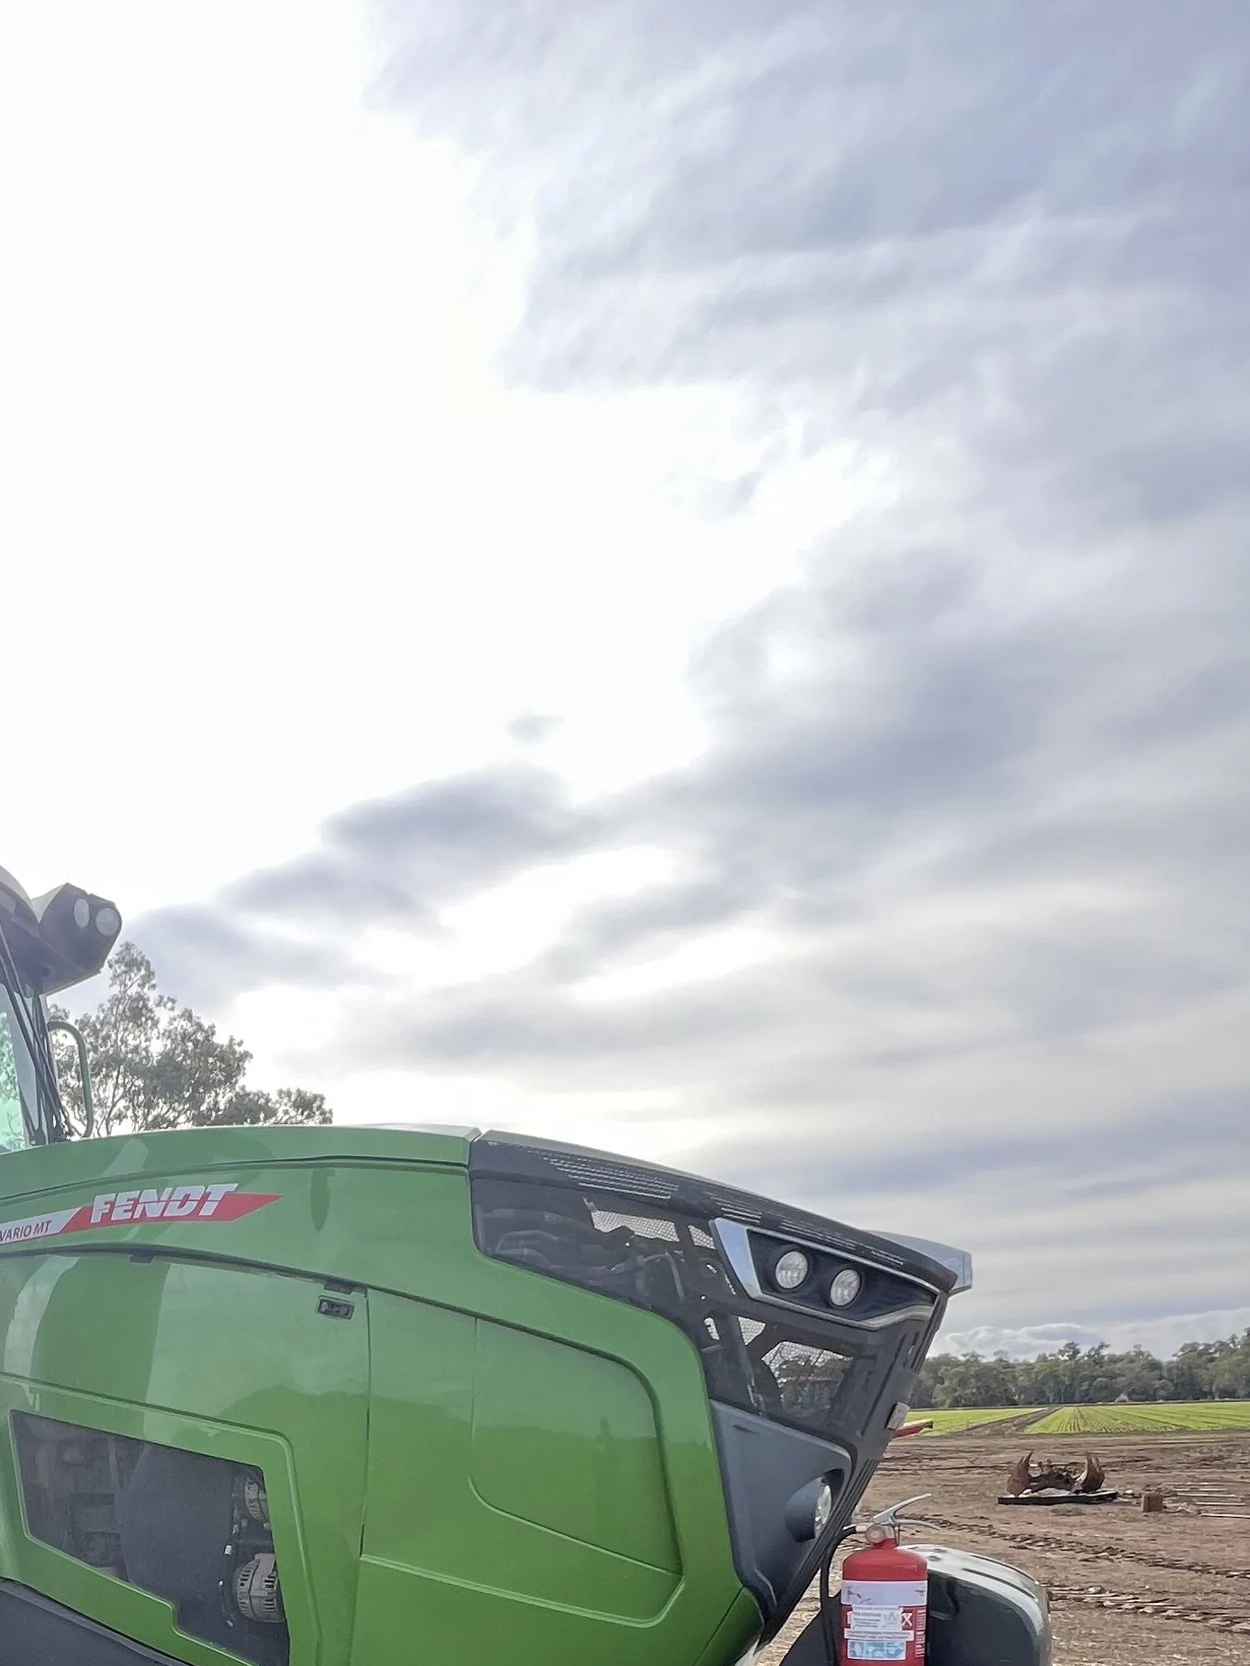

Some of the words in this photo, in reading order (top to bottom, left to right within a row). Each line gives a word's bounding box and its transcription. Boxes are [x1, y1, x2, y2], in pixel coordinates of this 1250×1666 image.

[90, 1182, 239, 1224] FENDT
[0, 1224, 32, 1242] VARIO
[33, 1220, 52, 1236] MT
